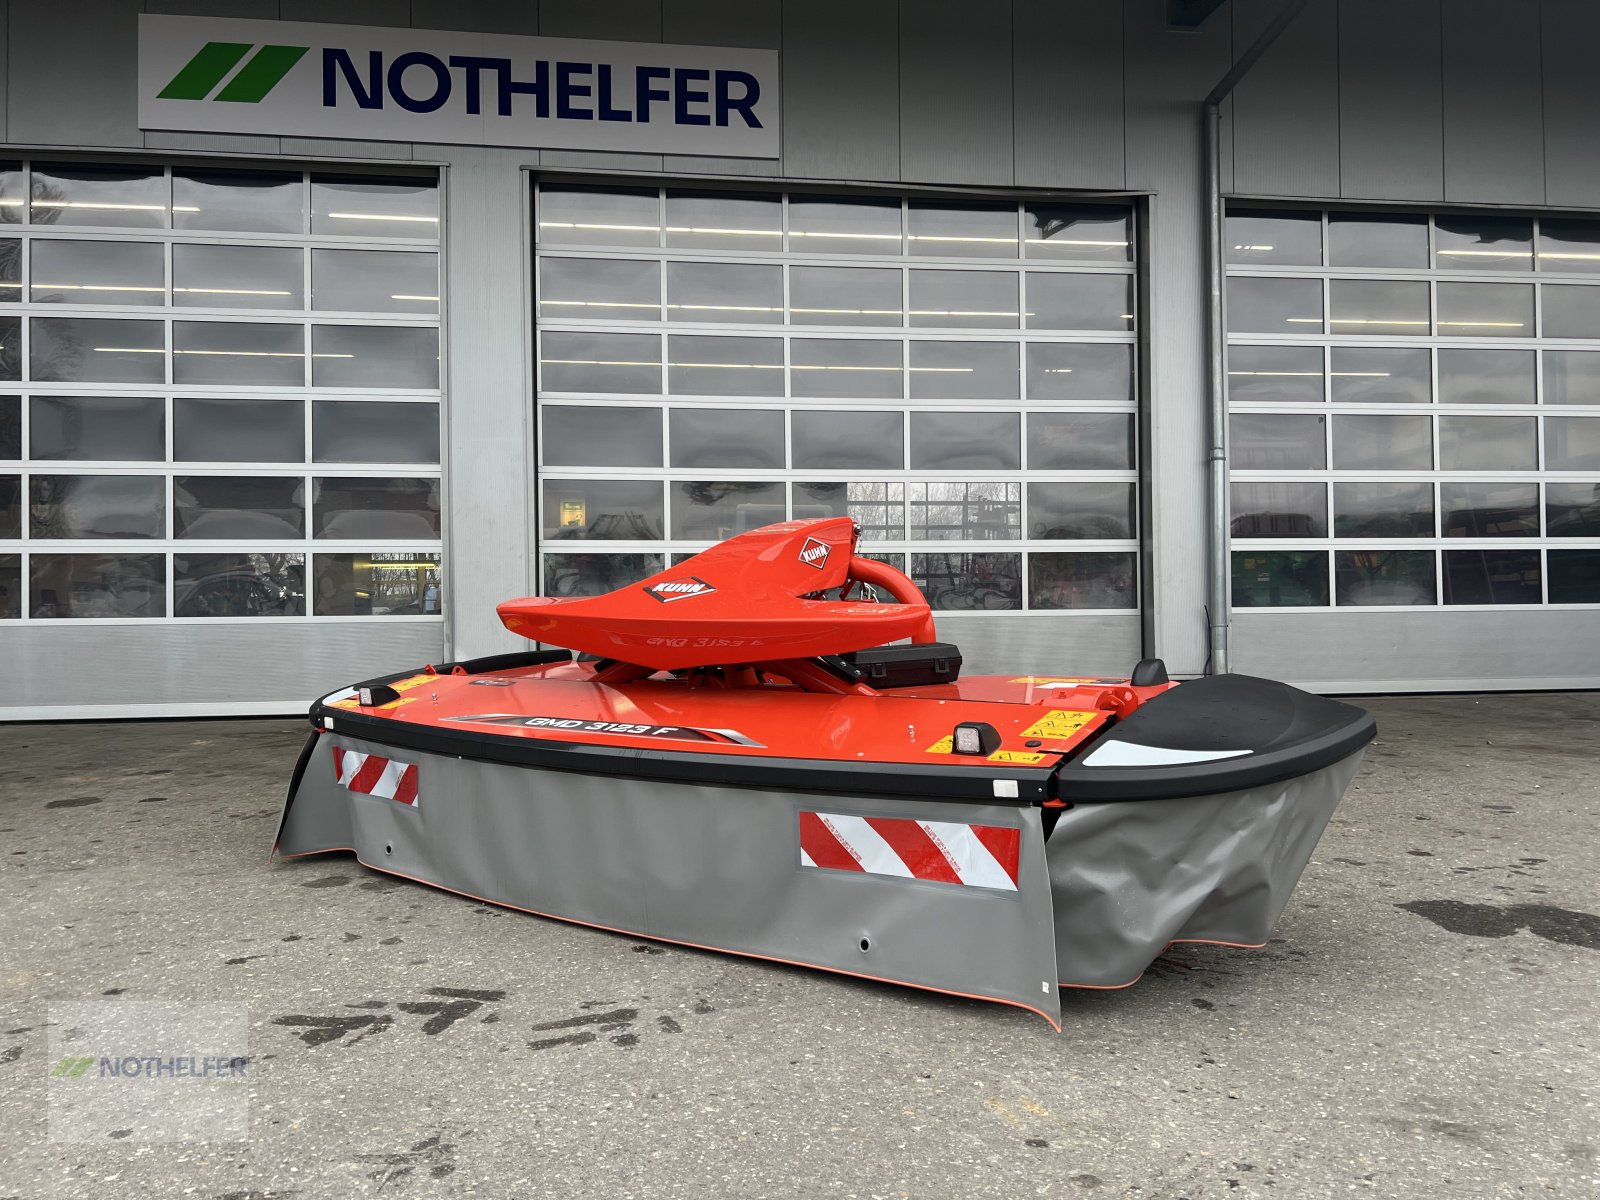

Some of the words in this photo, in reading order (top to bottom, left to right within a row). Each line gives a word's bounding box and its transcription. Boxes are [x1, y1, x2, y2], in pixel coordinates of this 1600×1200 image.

[322, 48, 764, 128] NOTHELFER
[803, 545, 828, 562] KUHN
[652, 583, 705, 592] KUHN
[525, 717, 583, 728] GMD
[585, 722, 651, 734] 3123
[652, 727, 679, 735] F
